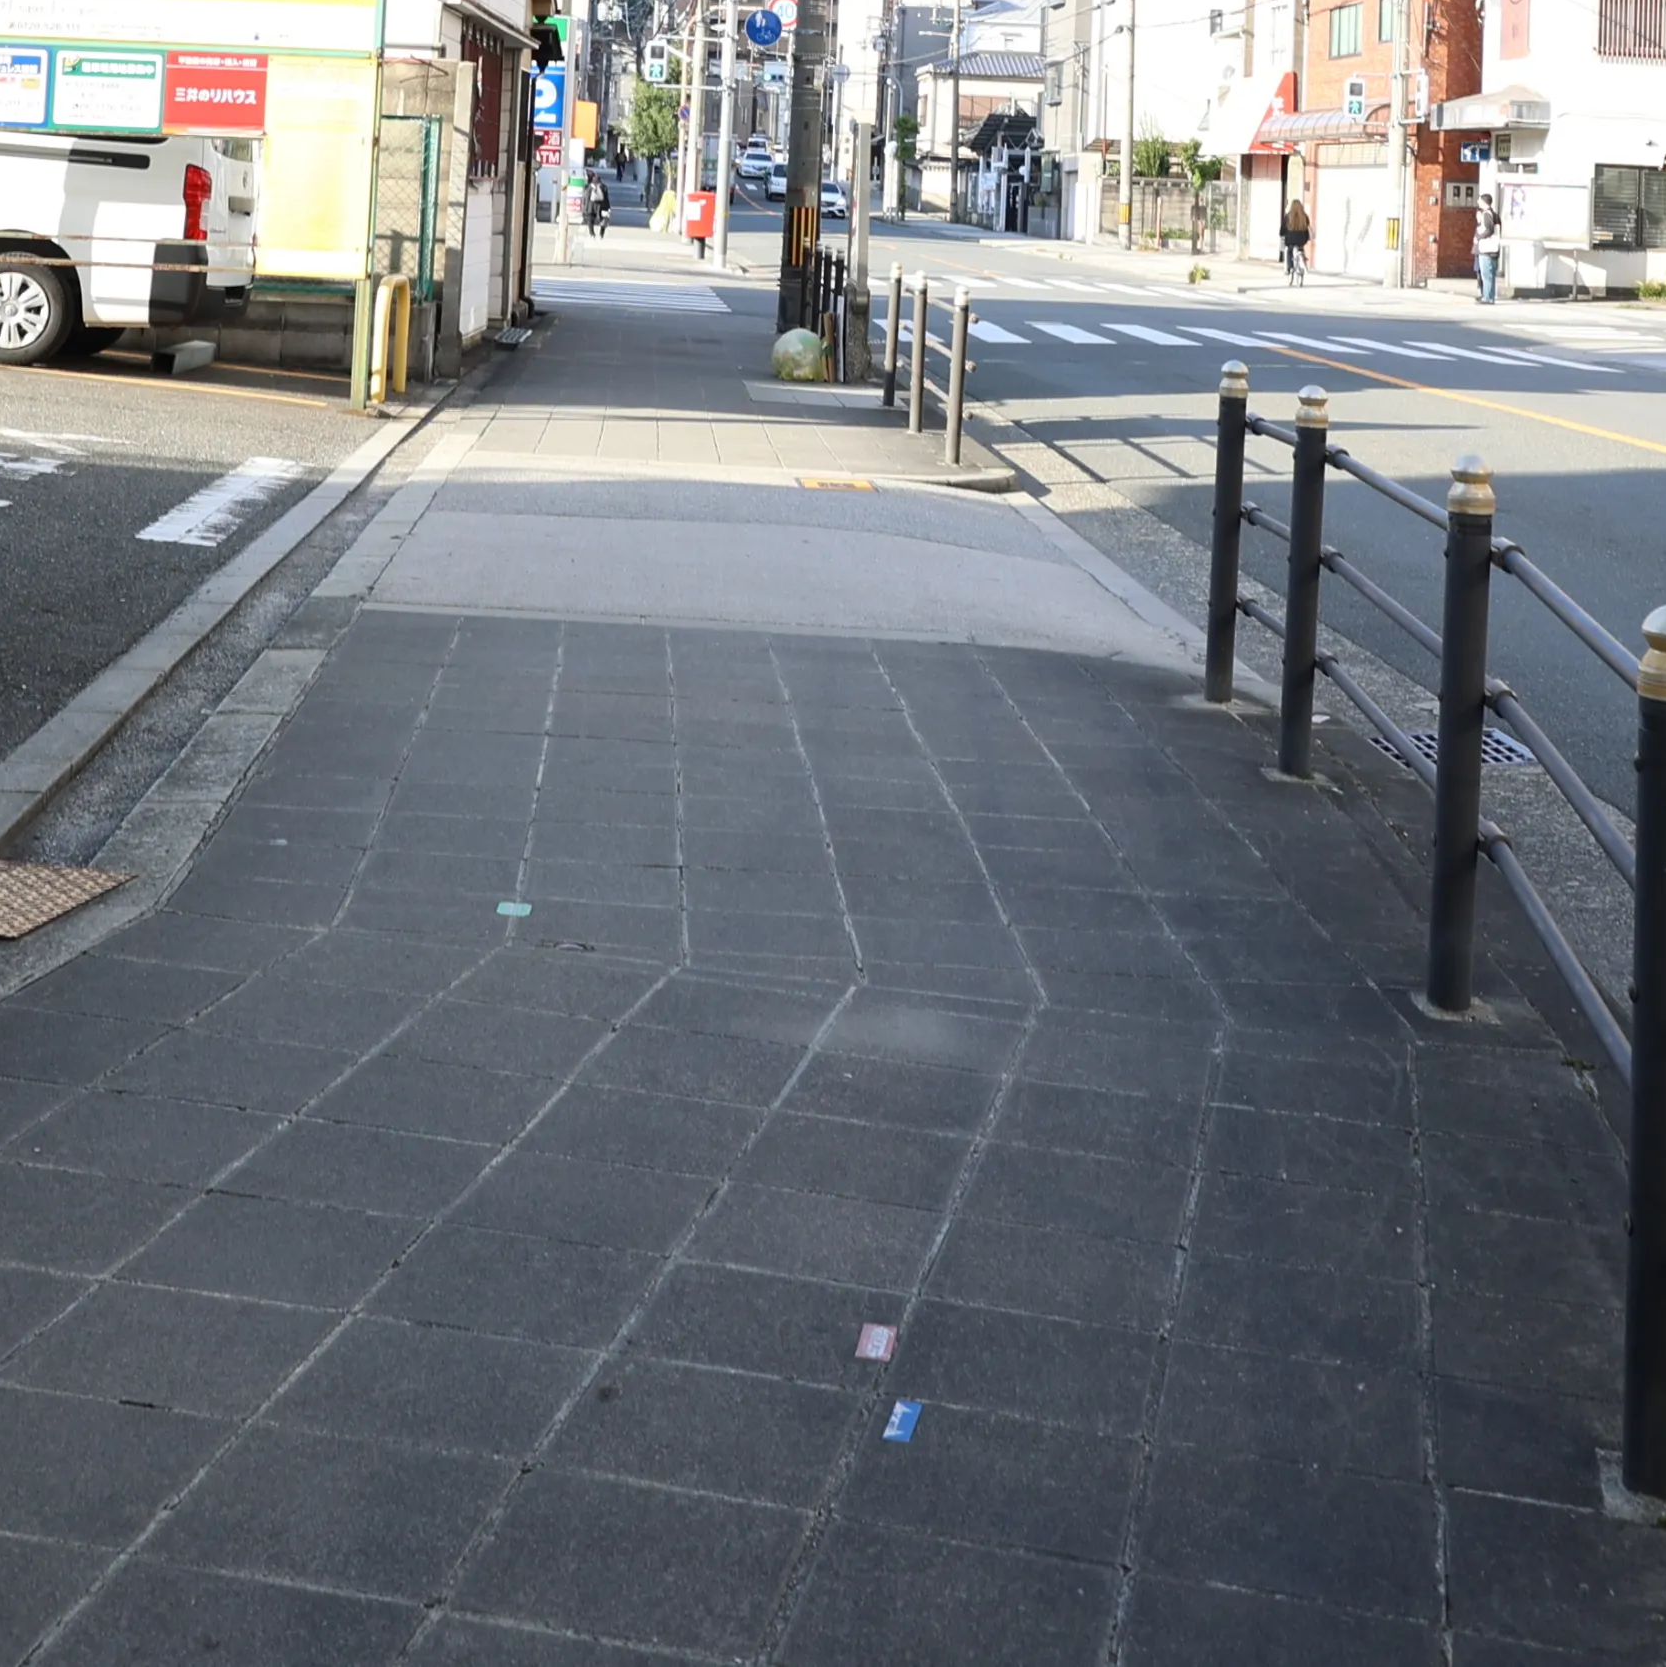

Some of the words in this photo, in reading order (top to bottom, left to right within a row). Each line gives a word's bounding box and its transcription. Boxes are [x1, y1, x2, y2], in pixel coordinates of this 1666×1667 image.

[777, 4, 795, 20] 40
[174, 86, 257, 105] 三井のリハウス
